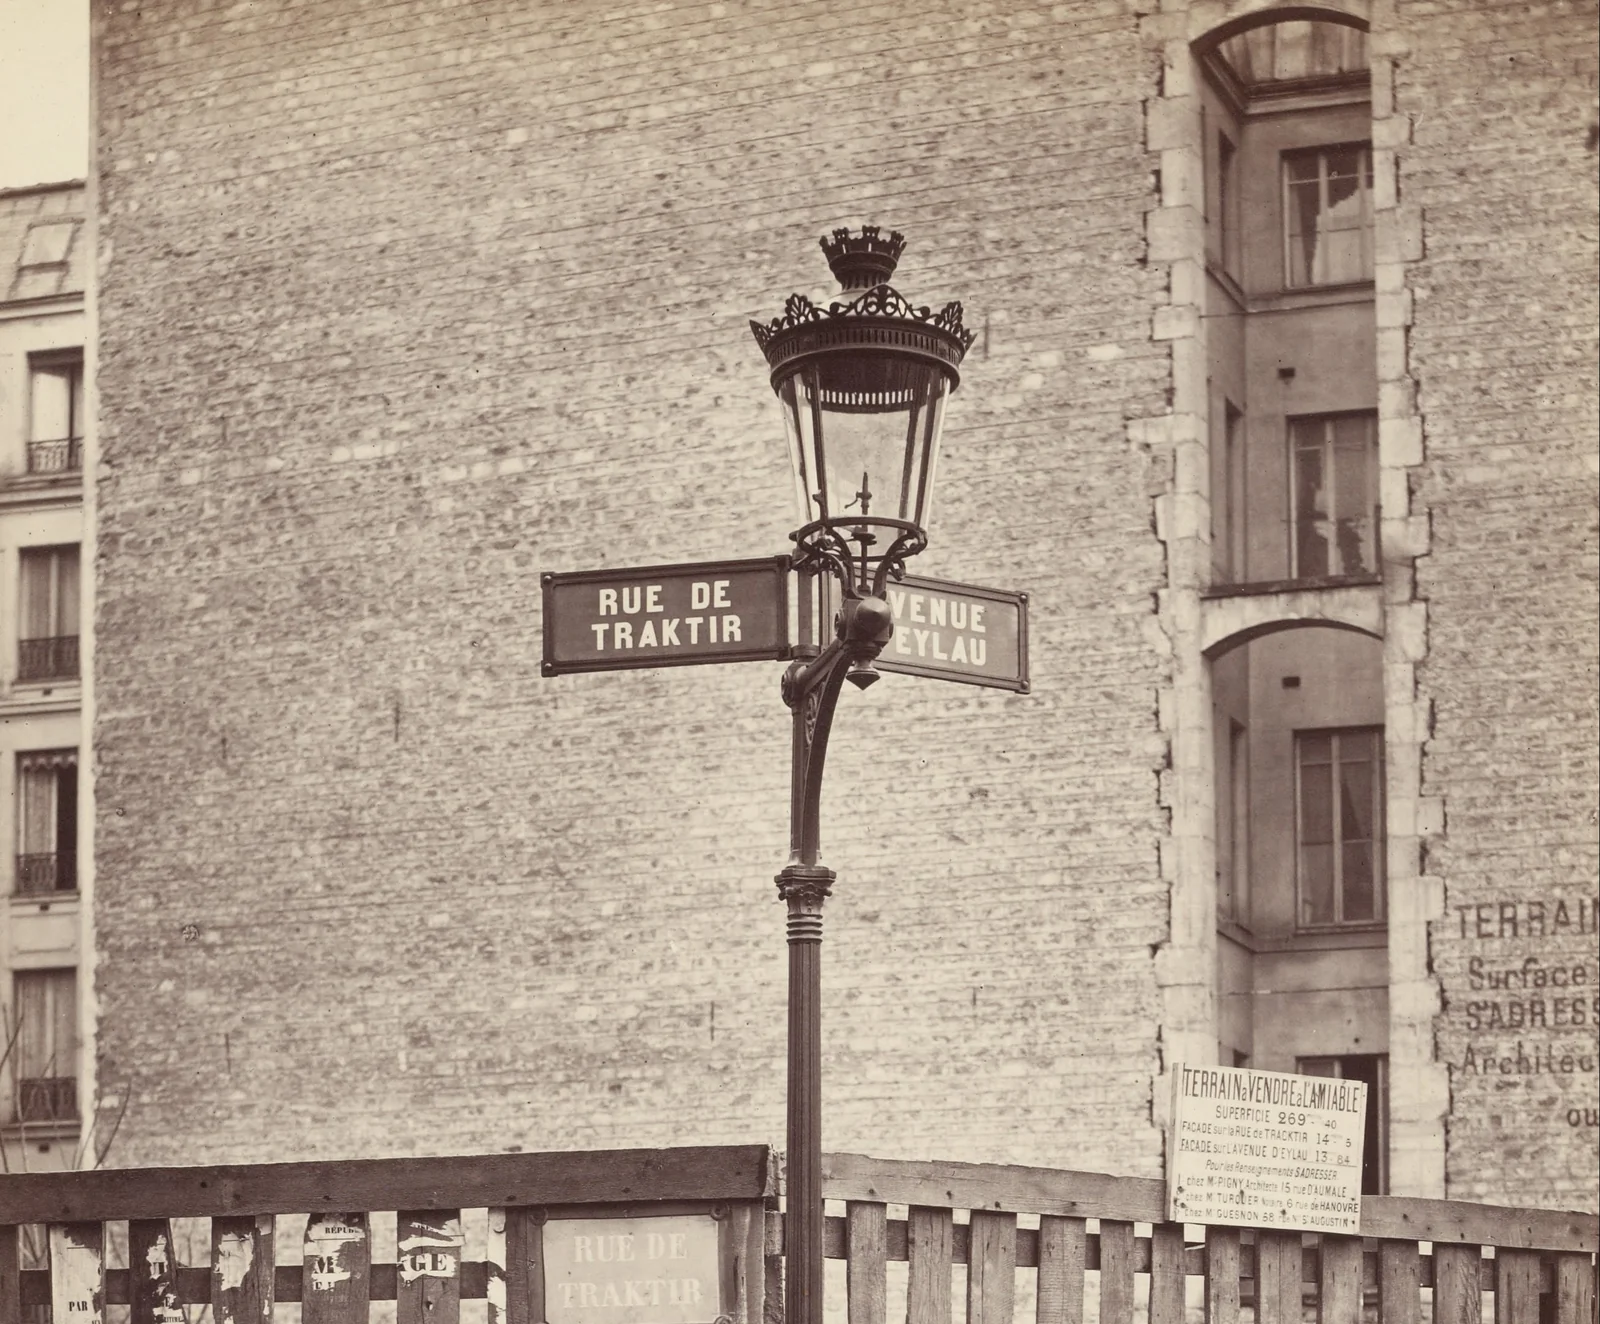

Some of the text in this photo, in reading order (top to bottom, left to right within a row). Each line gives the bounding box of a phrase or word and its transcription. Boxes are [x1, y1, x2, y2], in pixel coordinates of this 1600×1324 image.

[599, 580, 732, 616] RUE DE
[888, 590, 986, 633] VENUE
[591, 614, 742, 651] TRAKTIR
[1469, 956, 1587, 991] Surface
[1183, 1068, 1242, 1101] TERRAIN
[1248, 1074, 1297, 1107] VENDRE
[1303, 1081, 1360, 1113] L'AMIABLE
[1215, 1105, 1270, 1123] SUPERFICIE
[1278, 1111, 1306, 1126] 269
[1235, 1126, 1252, 1138] RUE
[1253, 1128, 1263, 1139] de
[1205, 1160, 1224, 1171] Pour
[1218, 1176, 1244, 1189] PIGNY
[1216, 1209, 1259, 1221] GUESNON
[1310, 1215, 1349, 1228] AUGUSTIN
[1320, 1202, 1359, 1213] HANOVRE
[573, 1232, 688, 1263] RUE DE
[558, 1277, 702, 1309] TRAKTIR
[69, 1301, 88, 1312] PAR
